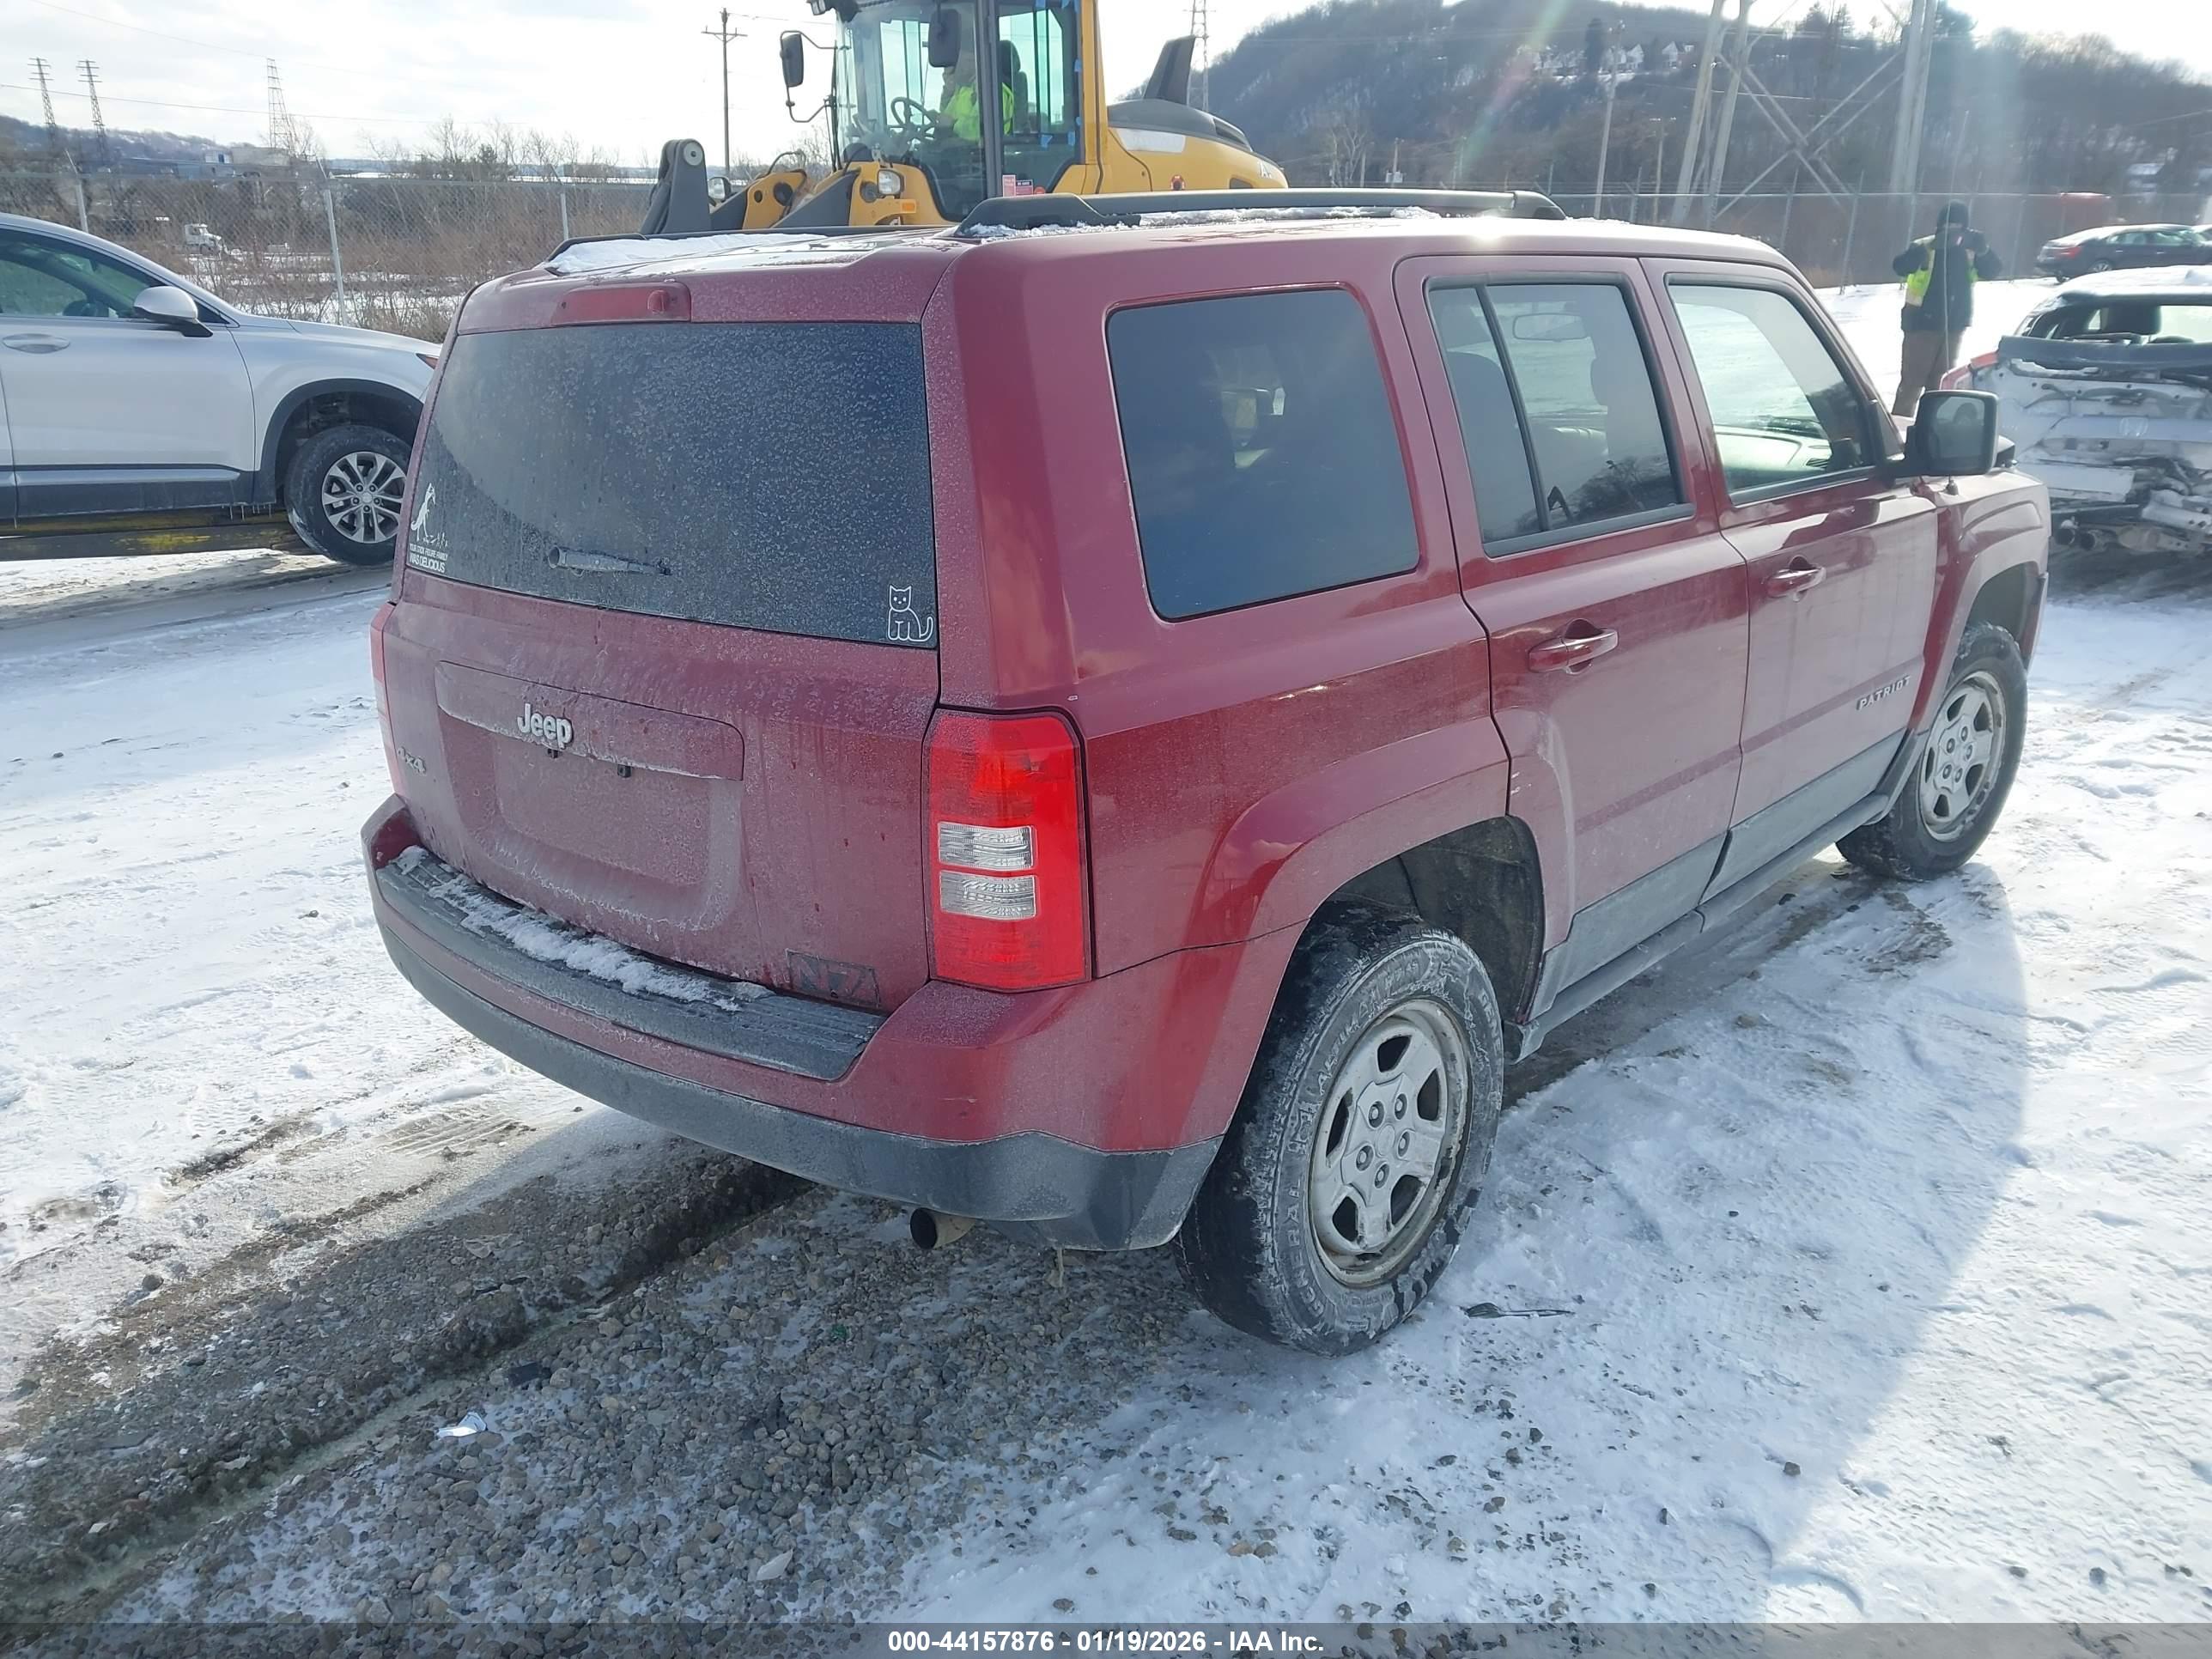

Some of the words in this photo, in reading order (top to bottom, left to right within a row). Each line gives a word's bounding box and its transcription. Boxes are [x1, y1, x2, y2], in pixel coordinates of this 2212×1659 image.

[1856, 675, 1911, 710] PATRIOT
[517, 702, 573, 749] Jeep
[397, 746, 426, 774] 4x4
